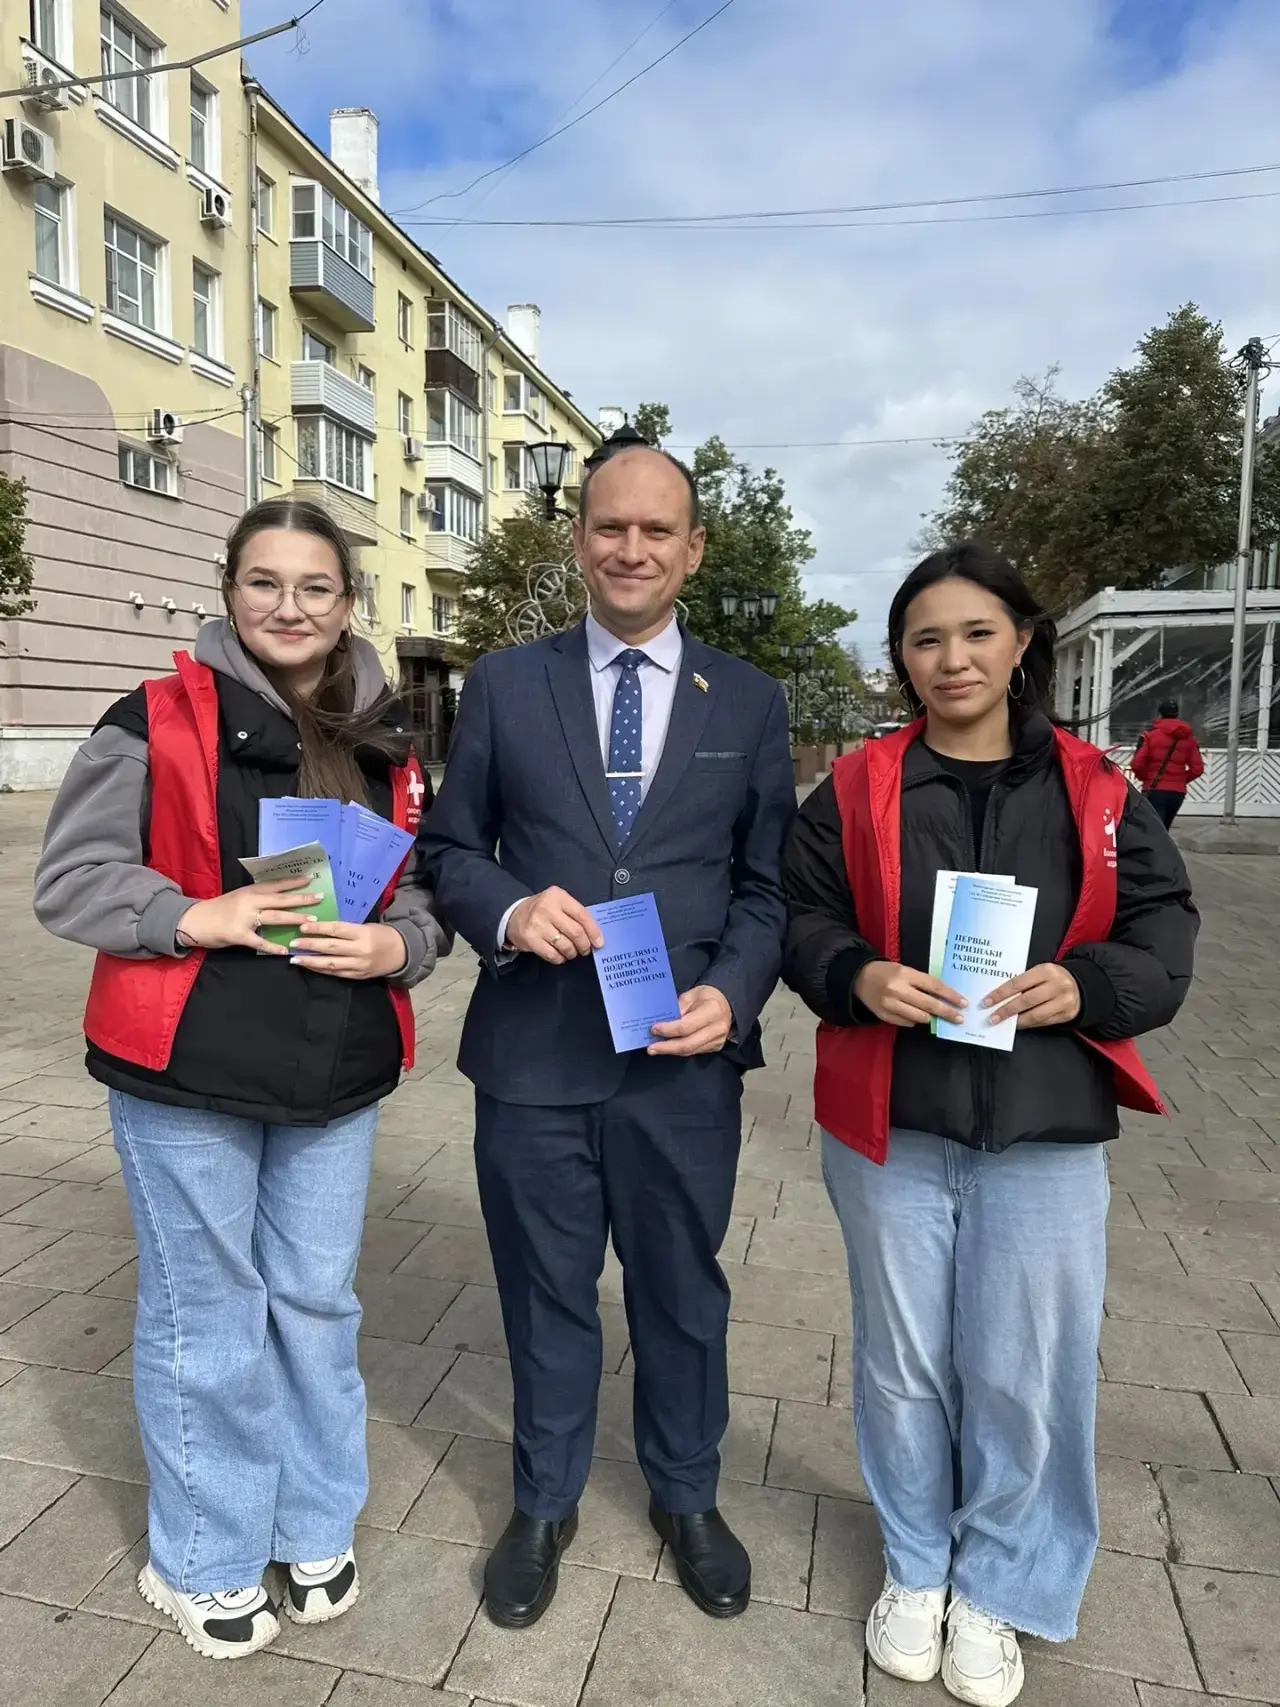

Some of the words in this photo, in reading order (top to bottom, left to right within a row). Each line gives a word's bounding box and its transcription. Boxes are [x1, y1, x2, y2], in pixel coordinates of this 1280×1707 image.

[954, 933, 993, 947] ПЕРВЫЕ
[601, 947, 651, 965] РОДИТЕЛЯМ
[651, 946, 659, 954] О
[953, 943, 1003, 958] ПРИЗНАКИ
[603, 955, 658, 973] ПОДРОСТКАХ
[952, 952, 998, 967] РАЗВИТИЯ
[604, 974, 613, 982] И
[613, 966, 649, 980] ПИВНОМ
[608, 971, 667, 990] АЛКОГОЛИЗМЕ
